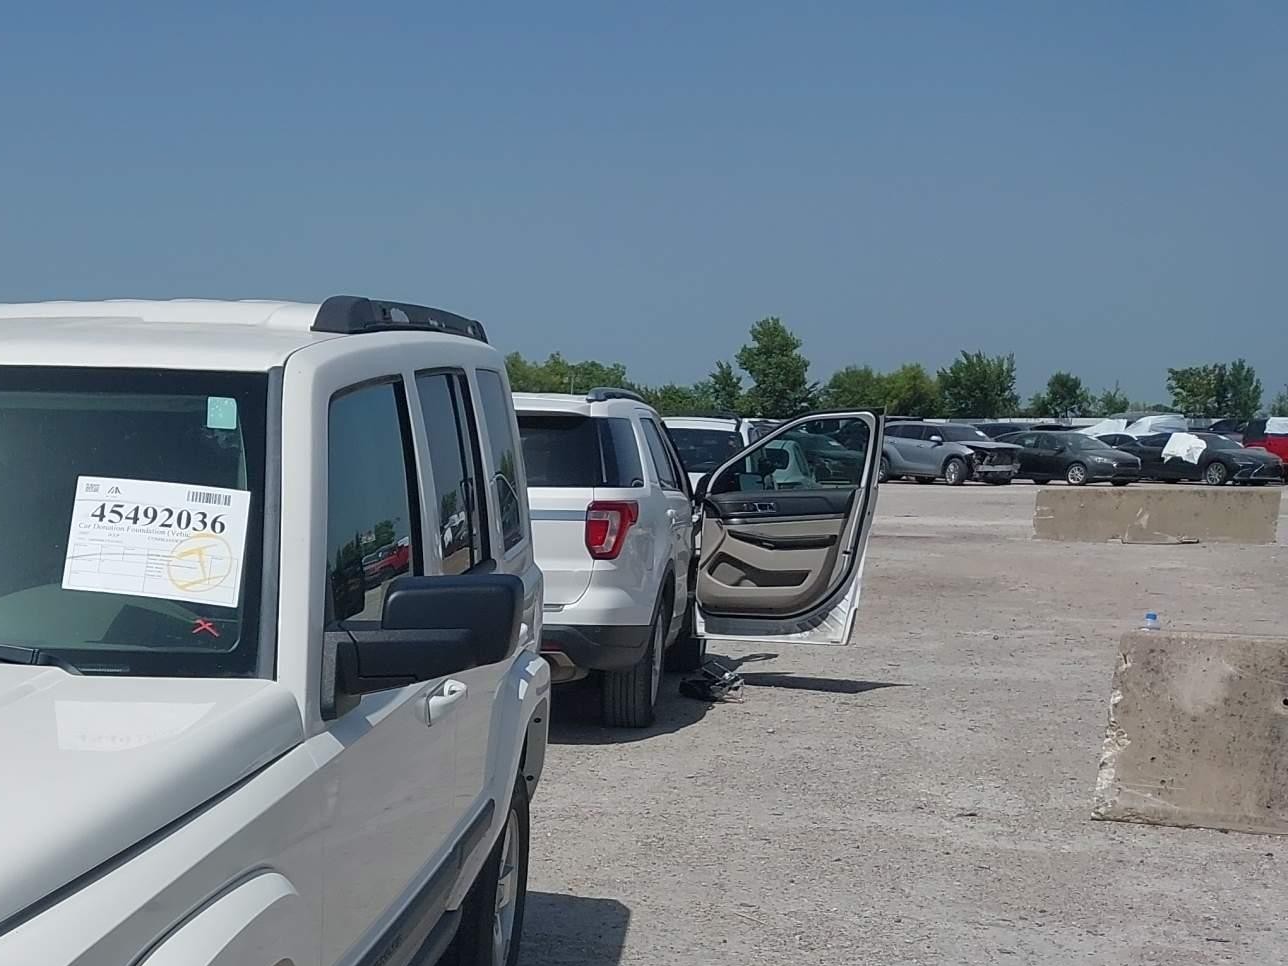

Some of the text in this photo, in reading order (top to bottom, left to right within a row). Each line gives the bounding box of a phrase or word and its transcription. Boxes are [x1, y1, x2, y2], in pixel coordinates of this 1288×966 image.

[78, 522, 92, 530] Car
[93, 523, 125, 533] Donation
[126, 525, 166, 536] Foundation
[91, 502, 227, 535] 45492036
